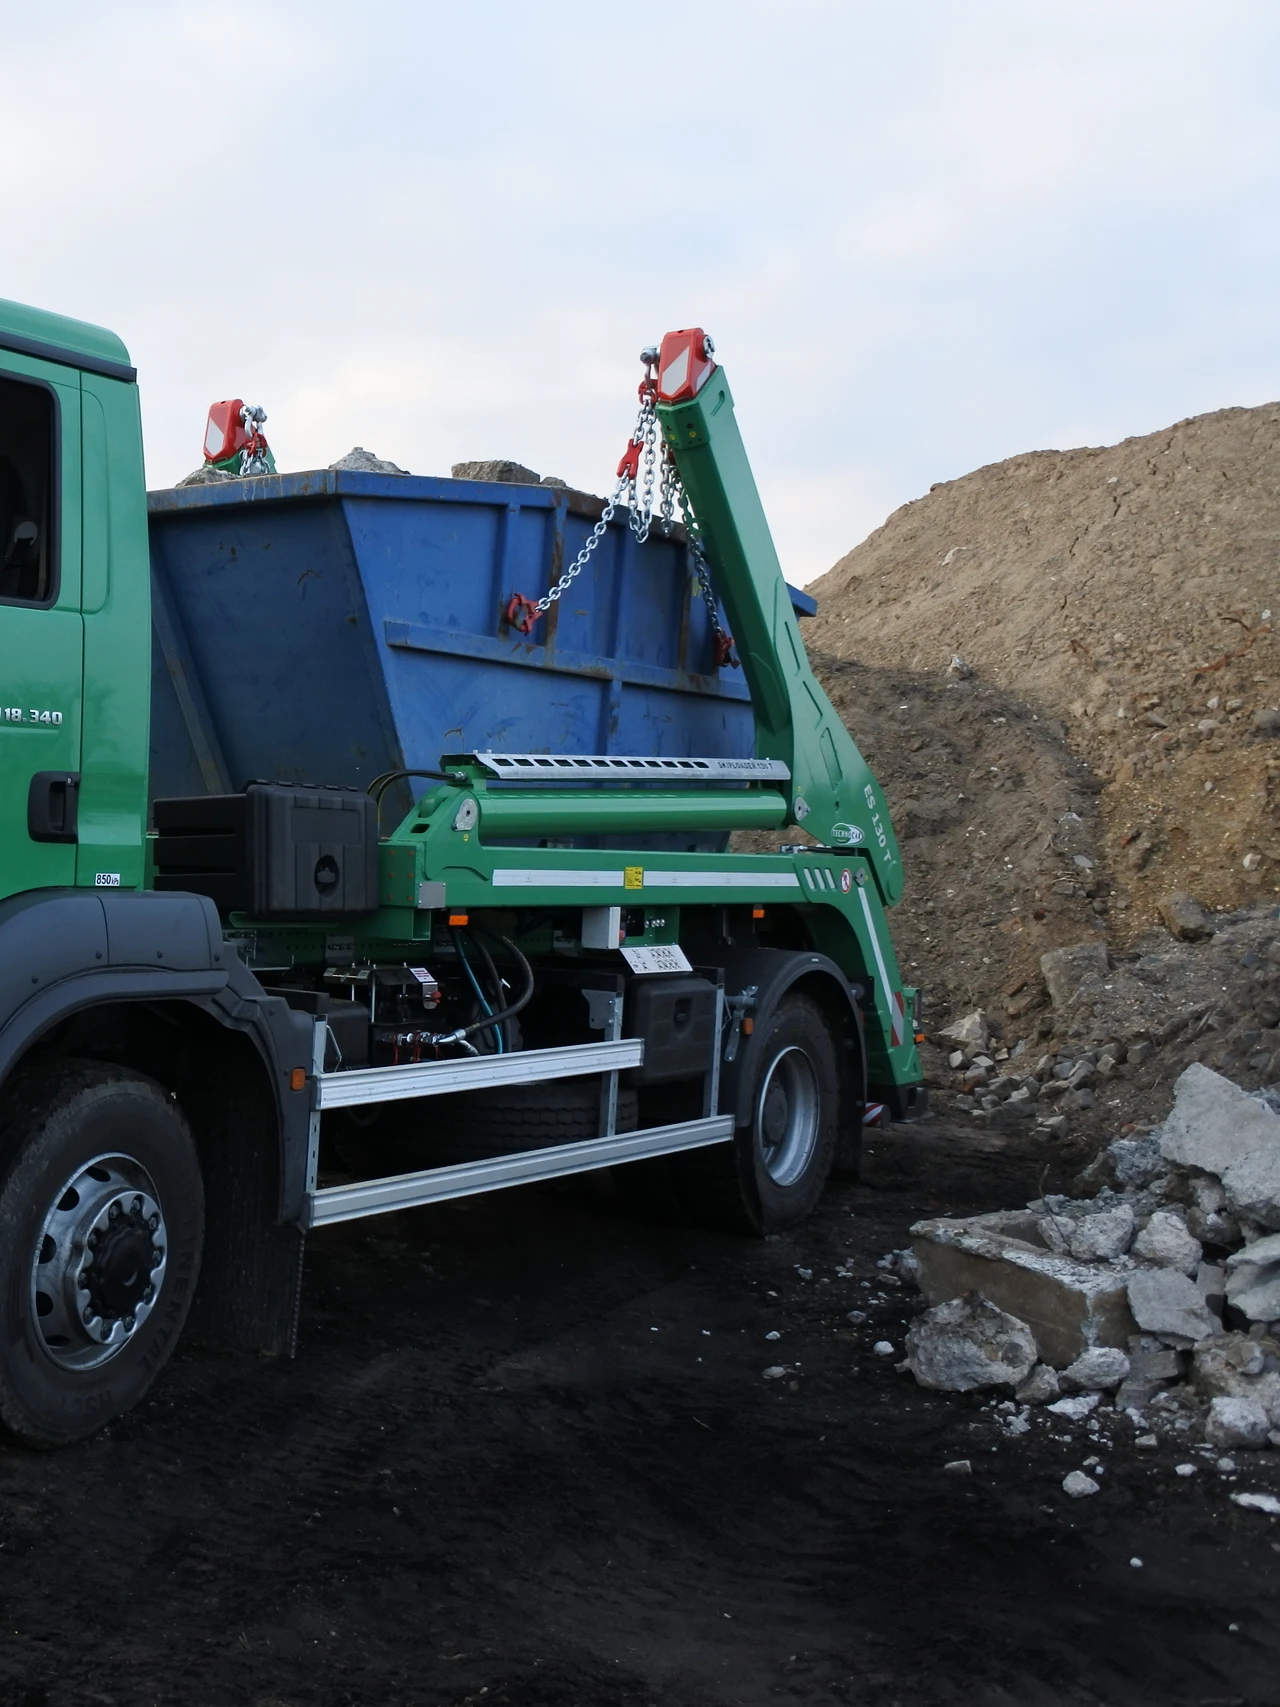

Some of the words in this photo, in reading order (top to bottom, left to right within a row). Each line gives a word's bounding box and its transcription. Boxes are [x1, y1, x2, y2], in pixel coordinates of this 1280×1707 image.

[717, 761, 756, 770] SKIPLOADER
[863, 783, 876, 810] ES
[871, 812, 887, 848] 130
[883, 848, 892, 862] T
